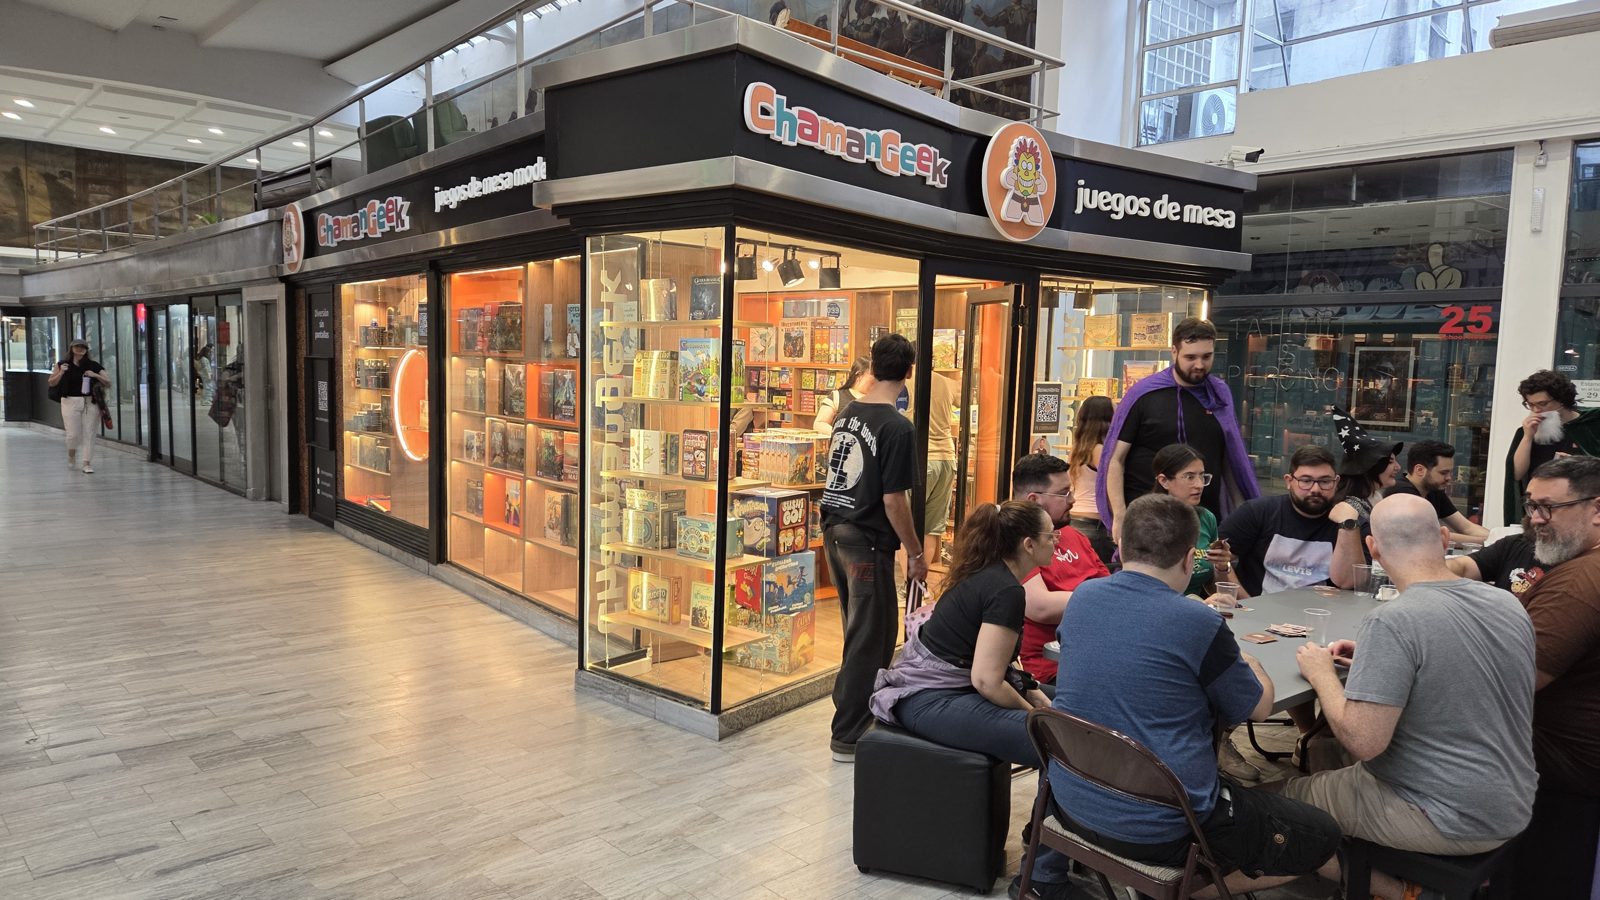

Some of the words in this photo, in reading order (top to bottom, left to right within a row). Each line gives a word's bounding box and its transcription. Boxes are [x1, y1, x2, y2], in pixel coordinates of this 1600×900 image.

[744, 82, 951, 188] ChamanGeek
[434, 186, 468, 213] juegos
[467, 176, 482, 199] de
[482, 171, 513, 195] mesa
[1074, 179, 1150, 220] juegos
[1153, 193, 1181, 221] de
[1182, 204, 1236, 229] mesa
[318, 196, 411, 247] ChamanGeek
[1439, 305, 1493, 334] 25
